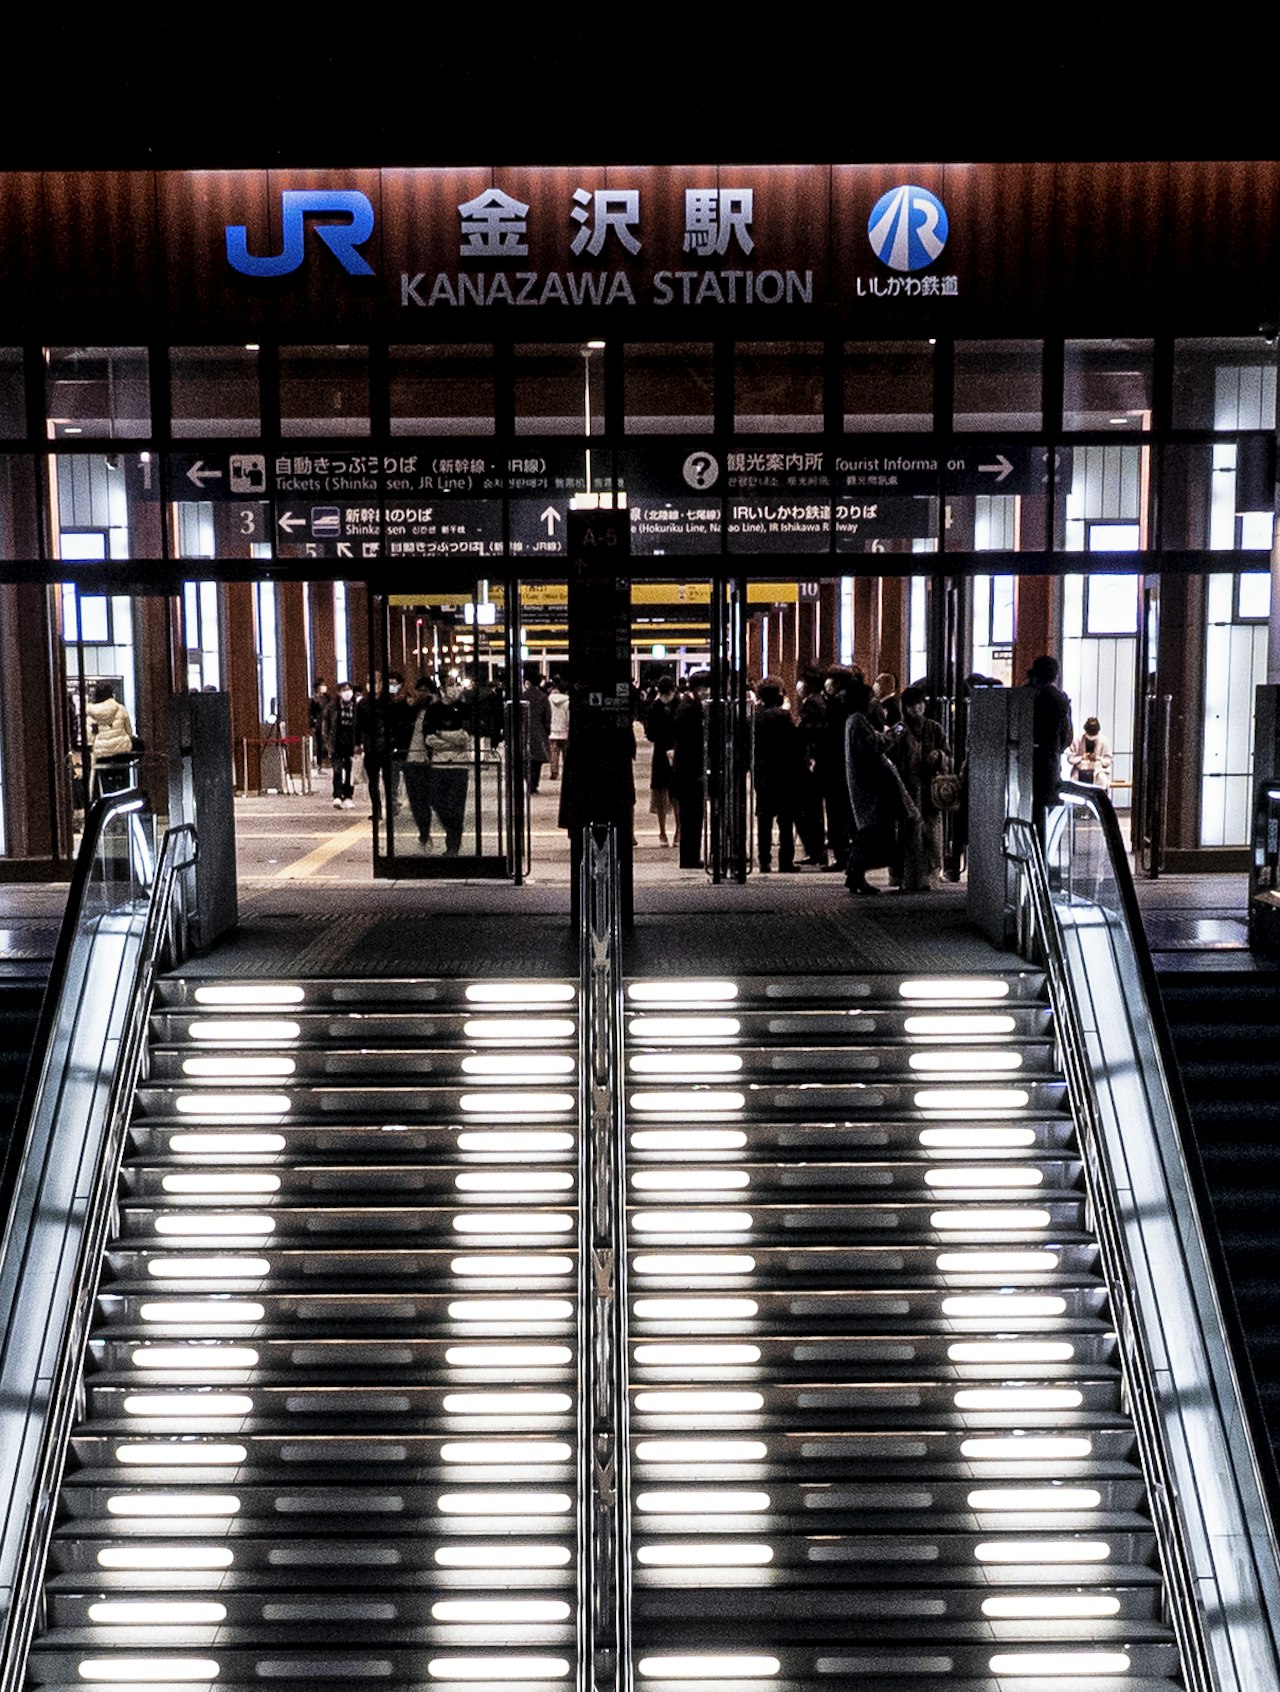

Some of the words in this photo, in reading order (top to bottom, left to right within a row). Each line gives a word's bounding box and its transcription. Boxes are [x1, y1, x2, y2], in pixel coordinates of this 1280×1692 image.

[458, 188, 755, 256] 金沢駅
[225, 190, 376, 277] JR
[400, 272, 636, 306] KANAZAWA
[653, 270, 813, 304] STATION
[856, 275, 959, 297] いしかわ鉄道
[727, 452, 824, 472] 観光案内所
[835, 457, 880, 471] Tourist
[884, 456, 966, 471] Informaon
[275, 477, 320, 490] Tickets
[324, 477, 414, 491] (Shinkasen,
[418, 476, 434, 489] JR
[437, 475, 473, 491] Line)
[239, 510, 256, 535] 3
[345, 523, 407, 536] Shinkasen
[639, 523, 684, 534] (Hokuriku
[685, 522, 708, 534] Line,
[710, 522, 740, 533] Naao
[780, 522, 821, 532] Ishikawa
